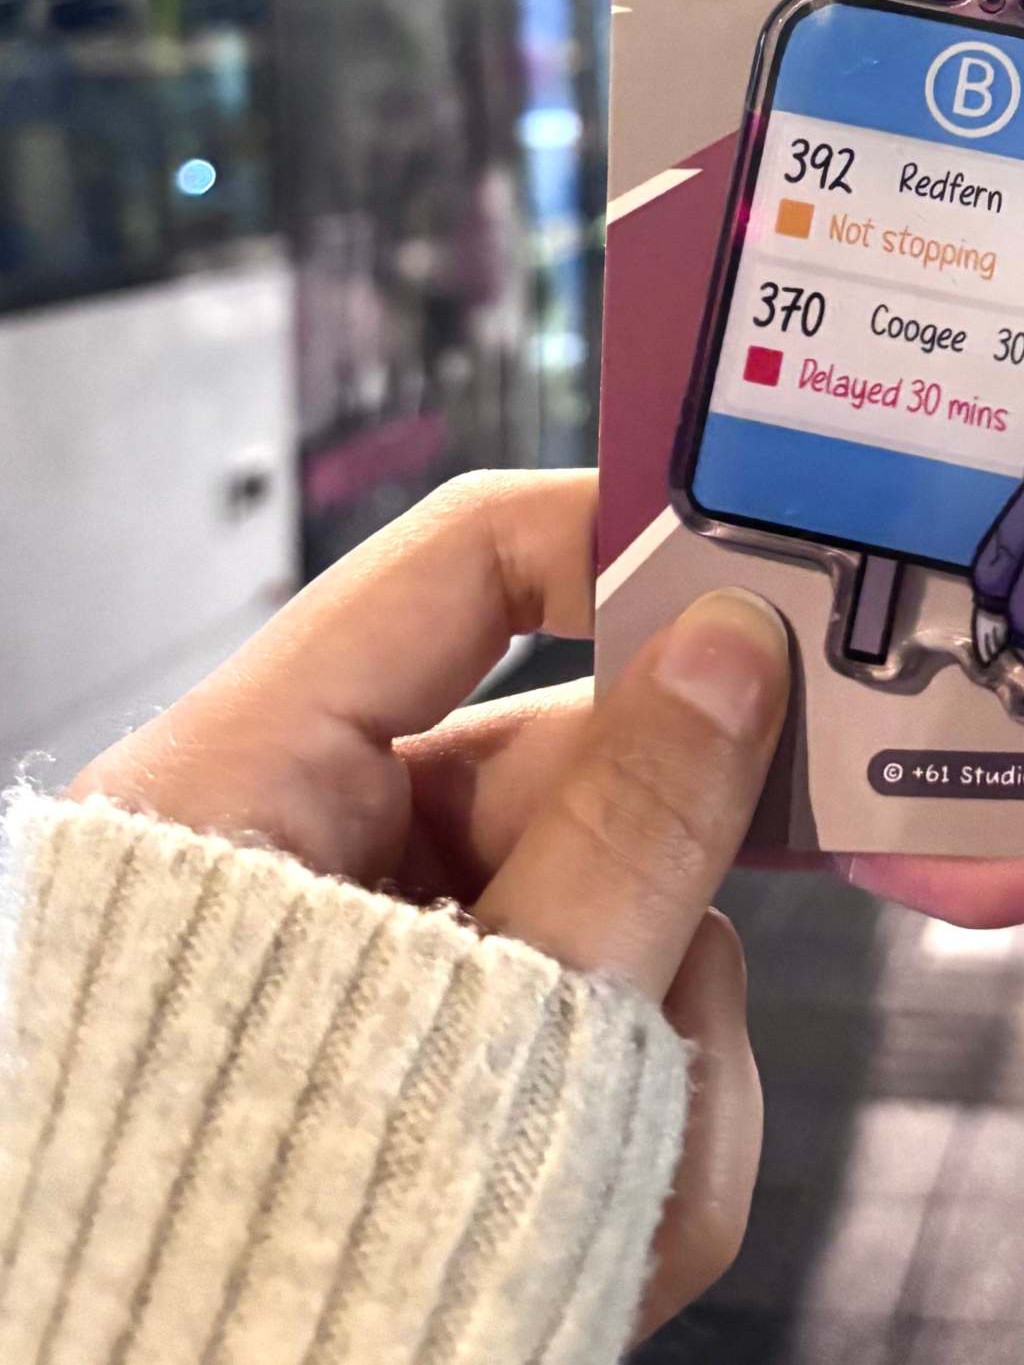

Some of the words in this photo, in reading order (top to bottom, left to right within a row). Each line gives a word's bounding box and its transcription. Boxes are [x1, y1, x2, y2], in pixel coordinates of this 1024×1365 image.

[953, 57, 995, 117] B
[783, 139, 855, 193] 392
[899, 162, 1003, 213] Redfern
[829, 213, 873, 249] Not
[882, 228, 997, 279] stopping
[752, 282, 826, 337] 370
[870, 304, 967, 353] Coogee
[798, 358, 902, 410] Delayed
[906, 380, 942, 416] 30
[948, 397, 1008, 432] mins
[912, 764, 950, 782] +61
